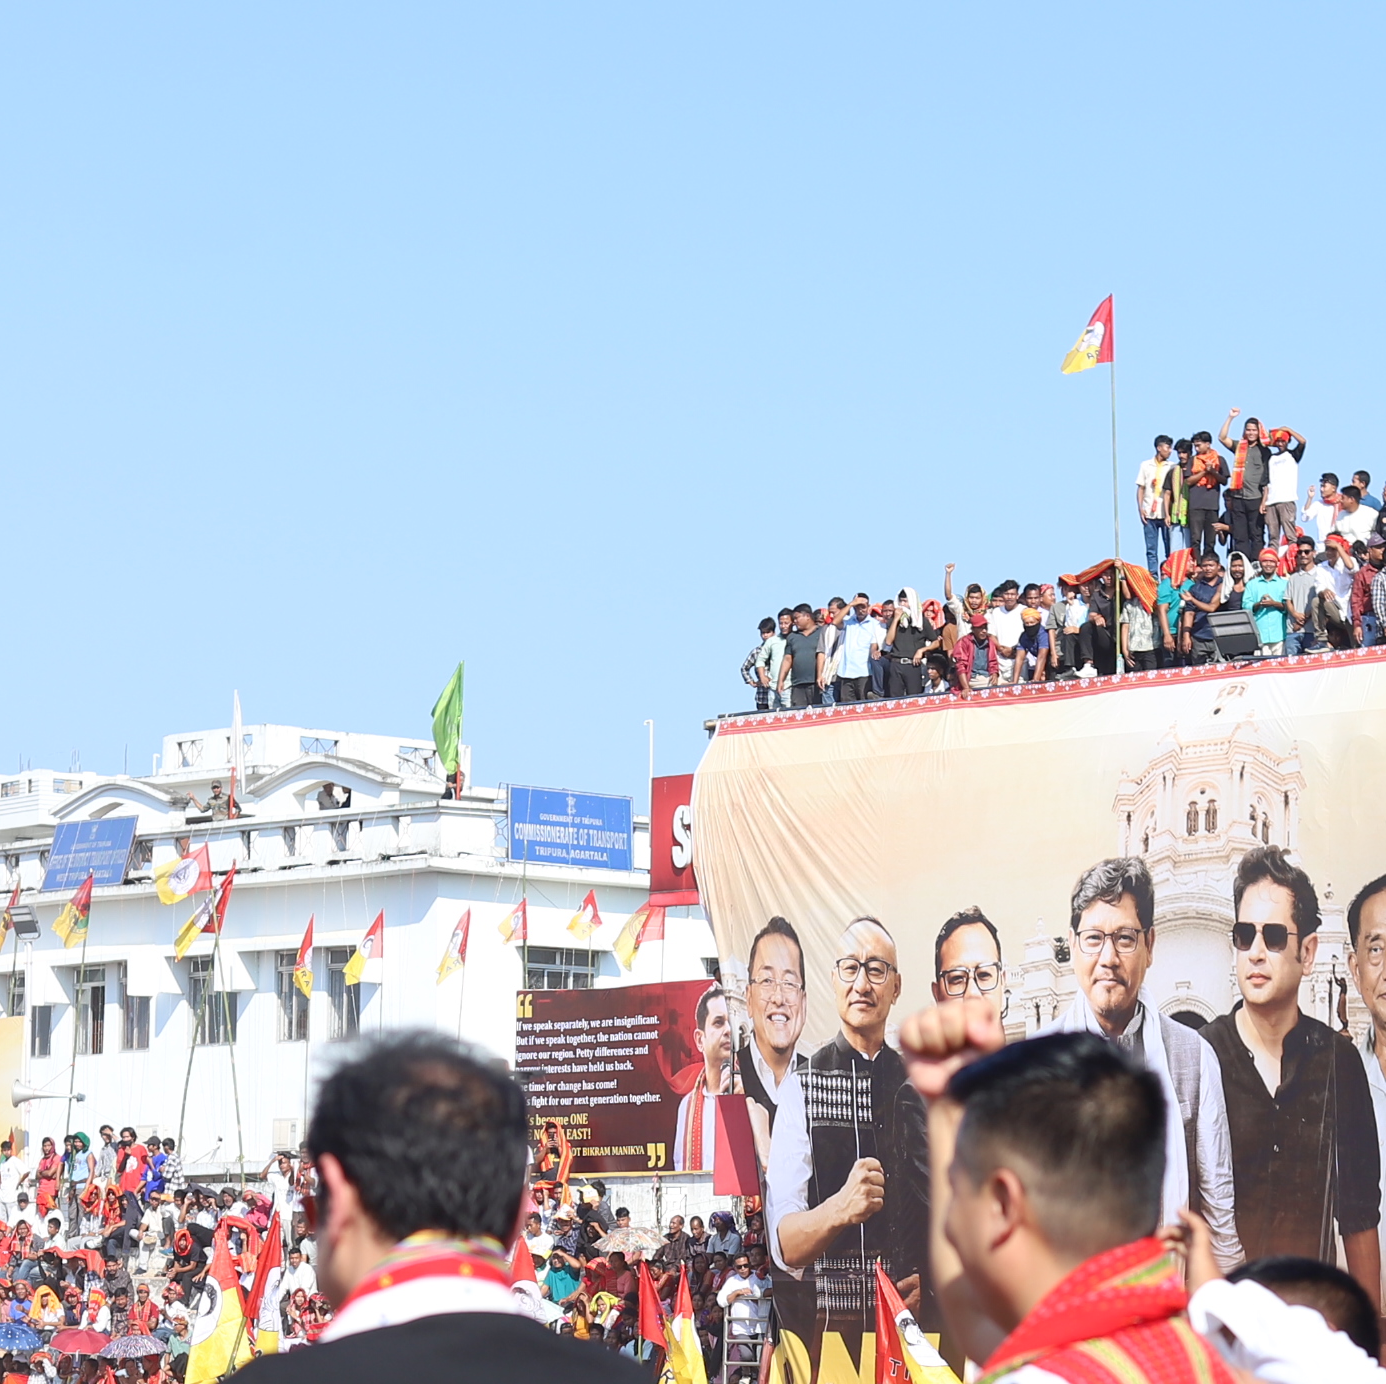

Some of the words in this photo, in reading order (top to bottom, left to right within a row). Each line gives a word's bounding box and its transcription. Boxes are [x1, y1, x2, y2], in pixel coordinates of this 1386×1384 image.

[540, 813, 573, 823] GOVERNMENT
[574, 816, 580, 824] OF
[582, 817, 602, 826] TRIPURA
[514, 823, 578, 845] COMMISSIONERATE
[579, 830, 588, 846] OF
[589, 831, 628, 850] TRANSPORT
[535, 846, 569, 860] TRIPURA,
[570, 850, 608, 861] AGARTALA
[516, 1022, 522, 1032] If
[523, 1023, 532, 1031] we
[533, 1021, 553, 1033] speak
[554, 1019, 589, 1032] separately,
[590, 1020, 600, 1028] we
[601, 1019, 613, 1027] are
[614, 1015, 660, 1028] insignificant.
[516, 1036, 528, 1046] But
[529, 1035, 534, 1045] if
[546, 1035, 565, 1047] speak
[566, 1033, 596, 1046] together,
[597, 1032, 608, 1042] the
[610, 1030, 632, 1041] nation
[634, 1030, 658, 1040] cannot
[515, 1051, 537, 1062] ignore
[538, 1051, 550, 1059] our
[551, 1049, 575, 1061] region.
[576, 1048, 594, 1060] Petty
[594, 1046, 633, 1057] differences
[635, 1045, 648, 1055] and
[572, 1063, 588, 1072] have
[589, 1062, 604, 1072] held
[605, 1063, 614, 1071] us
[615, 1060, 634, 1071] back.
[529, 1081, 545, 1091] time
[546, 1081, 556, 1091] for
[557, 1079, 581, 1093] change
[582, 1080, 594, 1090] has
[596, 1079, 617, 1089] come!
[532, 1096, 548, 1108] fight
[548, 1096, 560, 1105] for
[573, 1096, 589, 1105] next
[589, 1094, 628, 1107] generation
[629, 1092, 662, 1105] together.
[570, 1113, 588, 1125] ONE
[566, 1128, 591, 1140] EAST!
[583, 1146, 611, 1156] BIKRAM
[612, 1145, 645, 1156] MANIKYA
